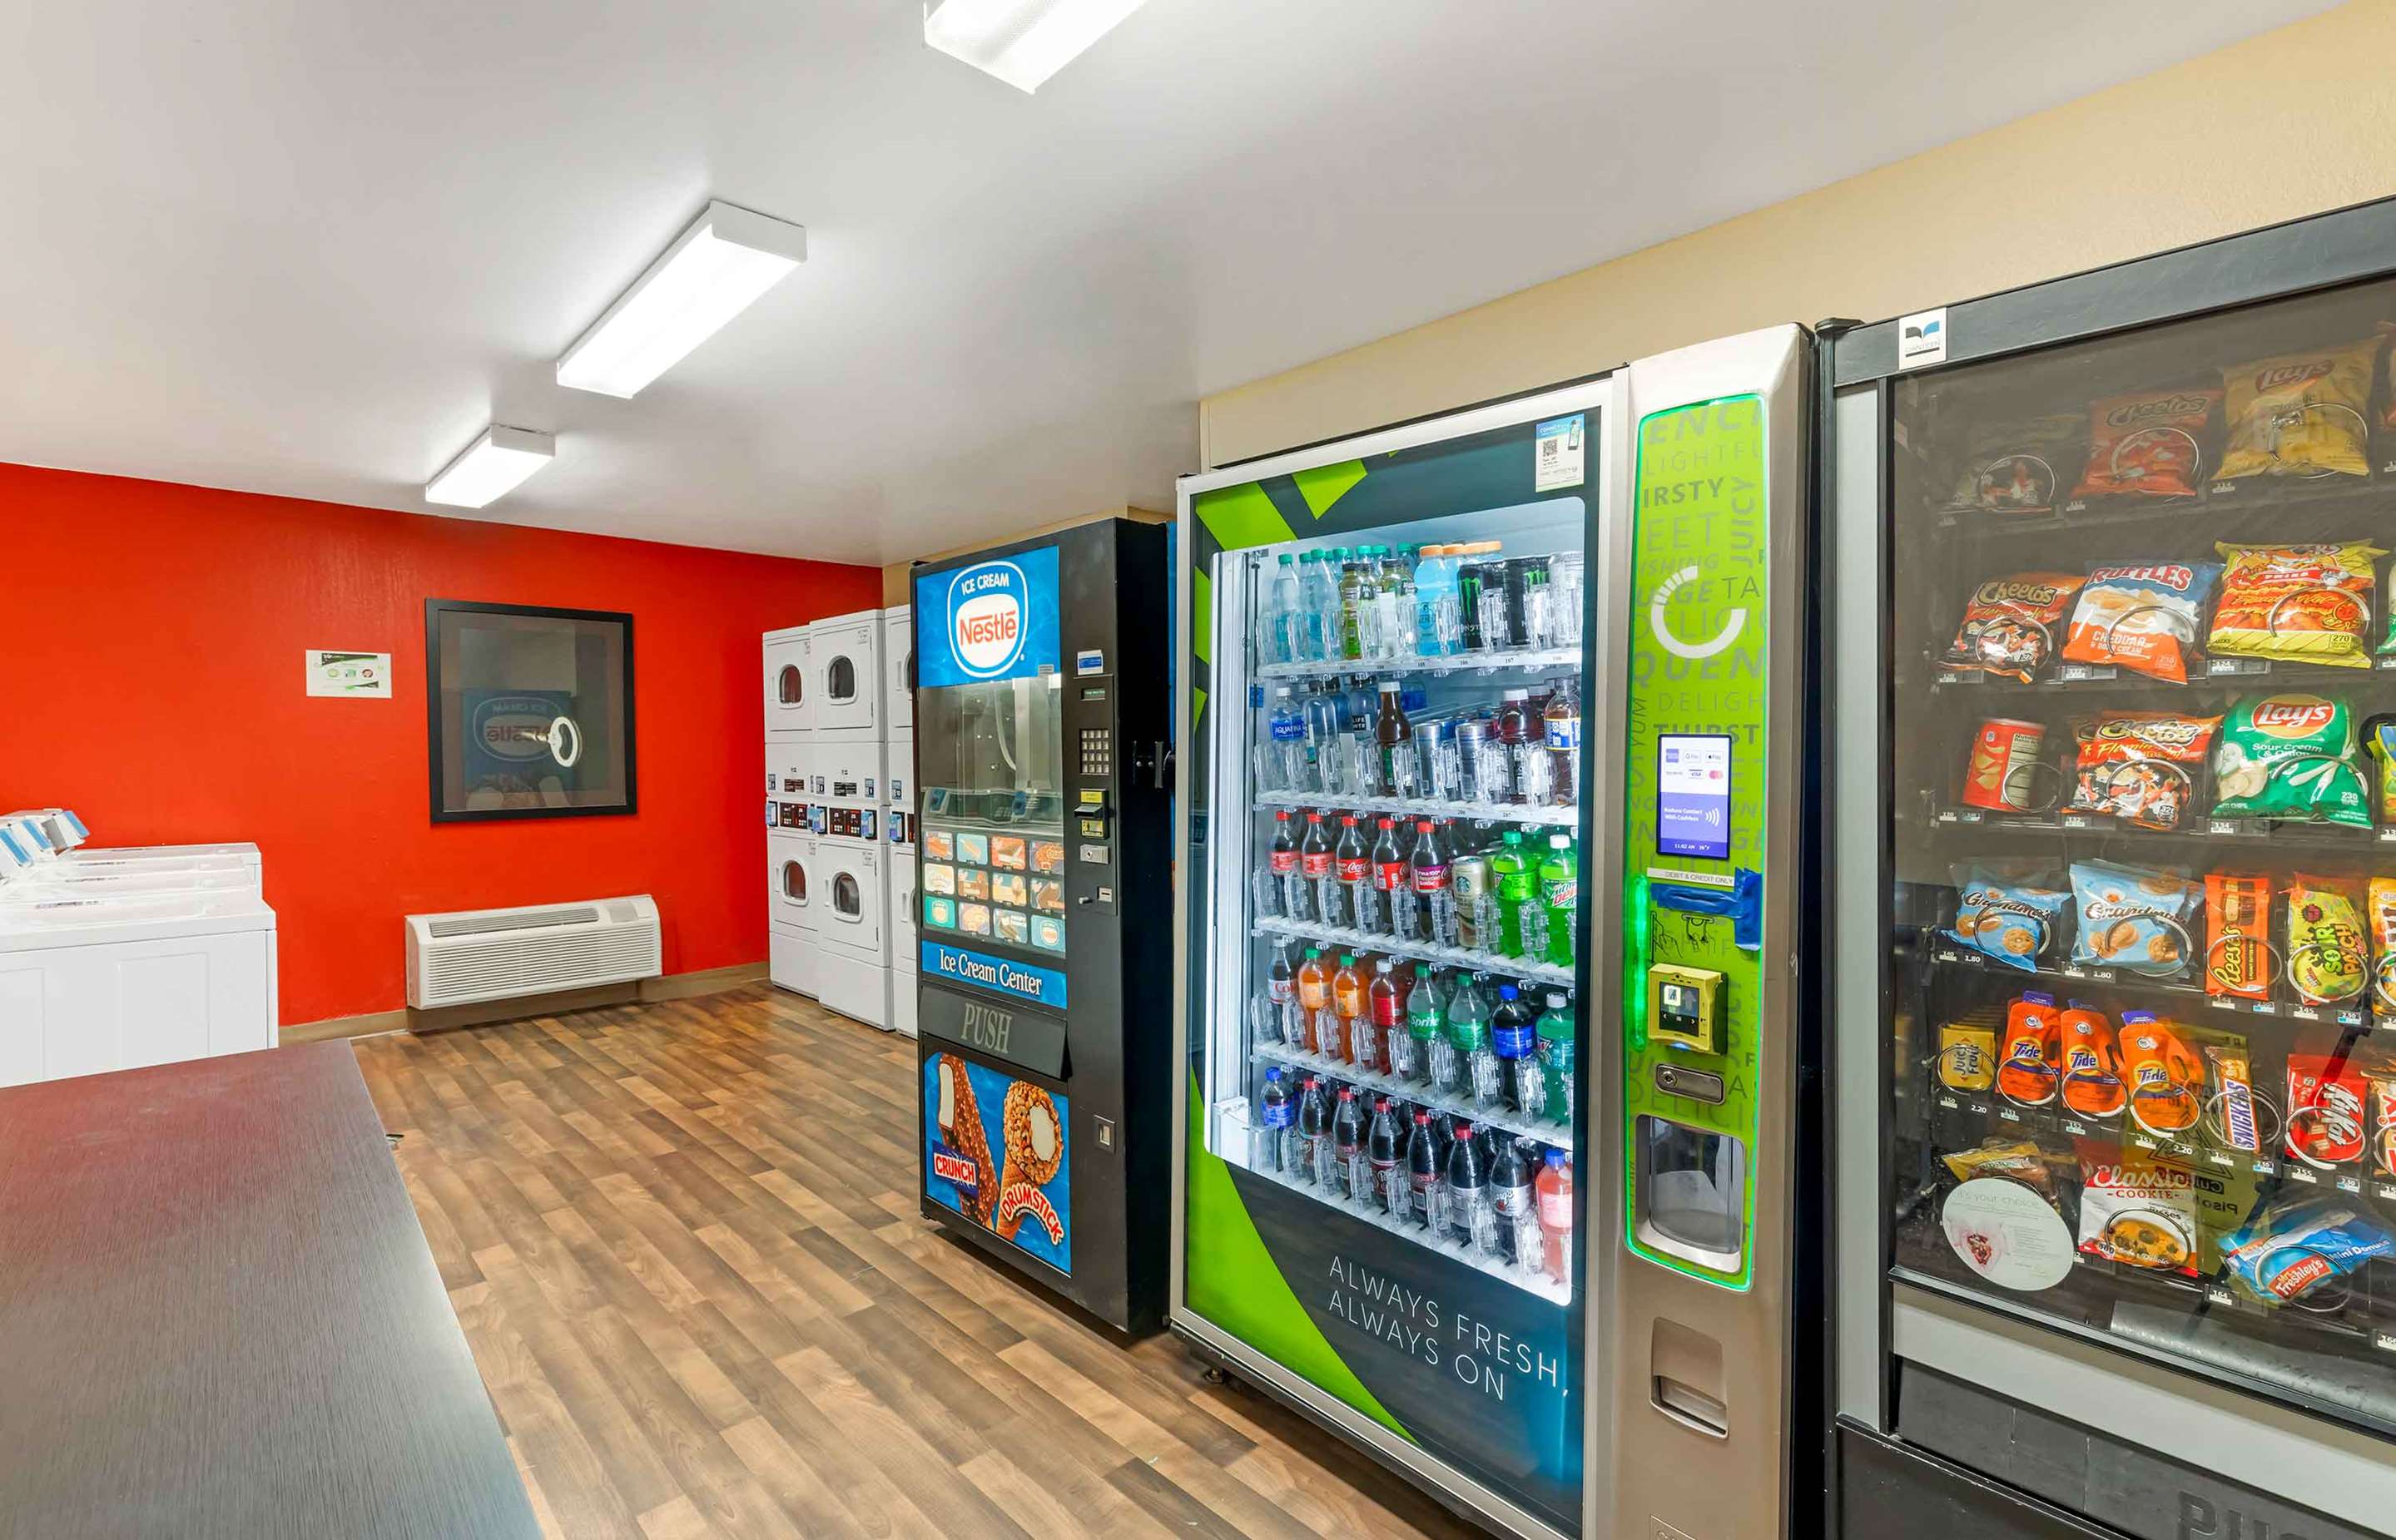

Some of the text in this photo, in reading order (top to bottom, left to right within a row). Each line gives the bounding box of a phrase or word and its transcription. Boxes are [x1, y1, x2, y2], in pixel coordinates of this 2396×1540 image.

[961, 573, 1009, 596] ICE CREAM
[2090, 566, 2192, 591] RUFFLES
[1979, 582, 2056, 605] Cheetos
[2092, 631, 2145, 646] CHEDDAR
[2253, 743, 2323, 753] Sour Cream
[1690, 874, 1713, 882] CREDIT
[940, 948, 1042, 996] Ice Cream Center
[2093, 970, 2112, 978] 1.80
[961, 1003, 1013, 1054] PUSH
[1411, 1015, 1440, 1027] Sprite
[2012, 1042, 2041, 1058] Tide
[2070, 1052, 2097, 1067] Tide
[2137, 1068, 2167, 1082] Tide
[1971, 1105, 1987, 1113] 2.20
[2225, 1081, 2256, 1150] SNICKERS
[2173, 1145, 2194, 1155] 2.20
[935, 1156, 975, 1183] CRUNCH
[2094, 1165, 2189, 1188] Classic
[1001, 1183, 1064, 1244] DRUMSTICK
[2276, 1258, 2324, 1296] Freshley's
[1329, 1255, 1568, 1398] ALWAYS FRESH,
[1329, 1290, 1504, 1400] ALWAYS ON
